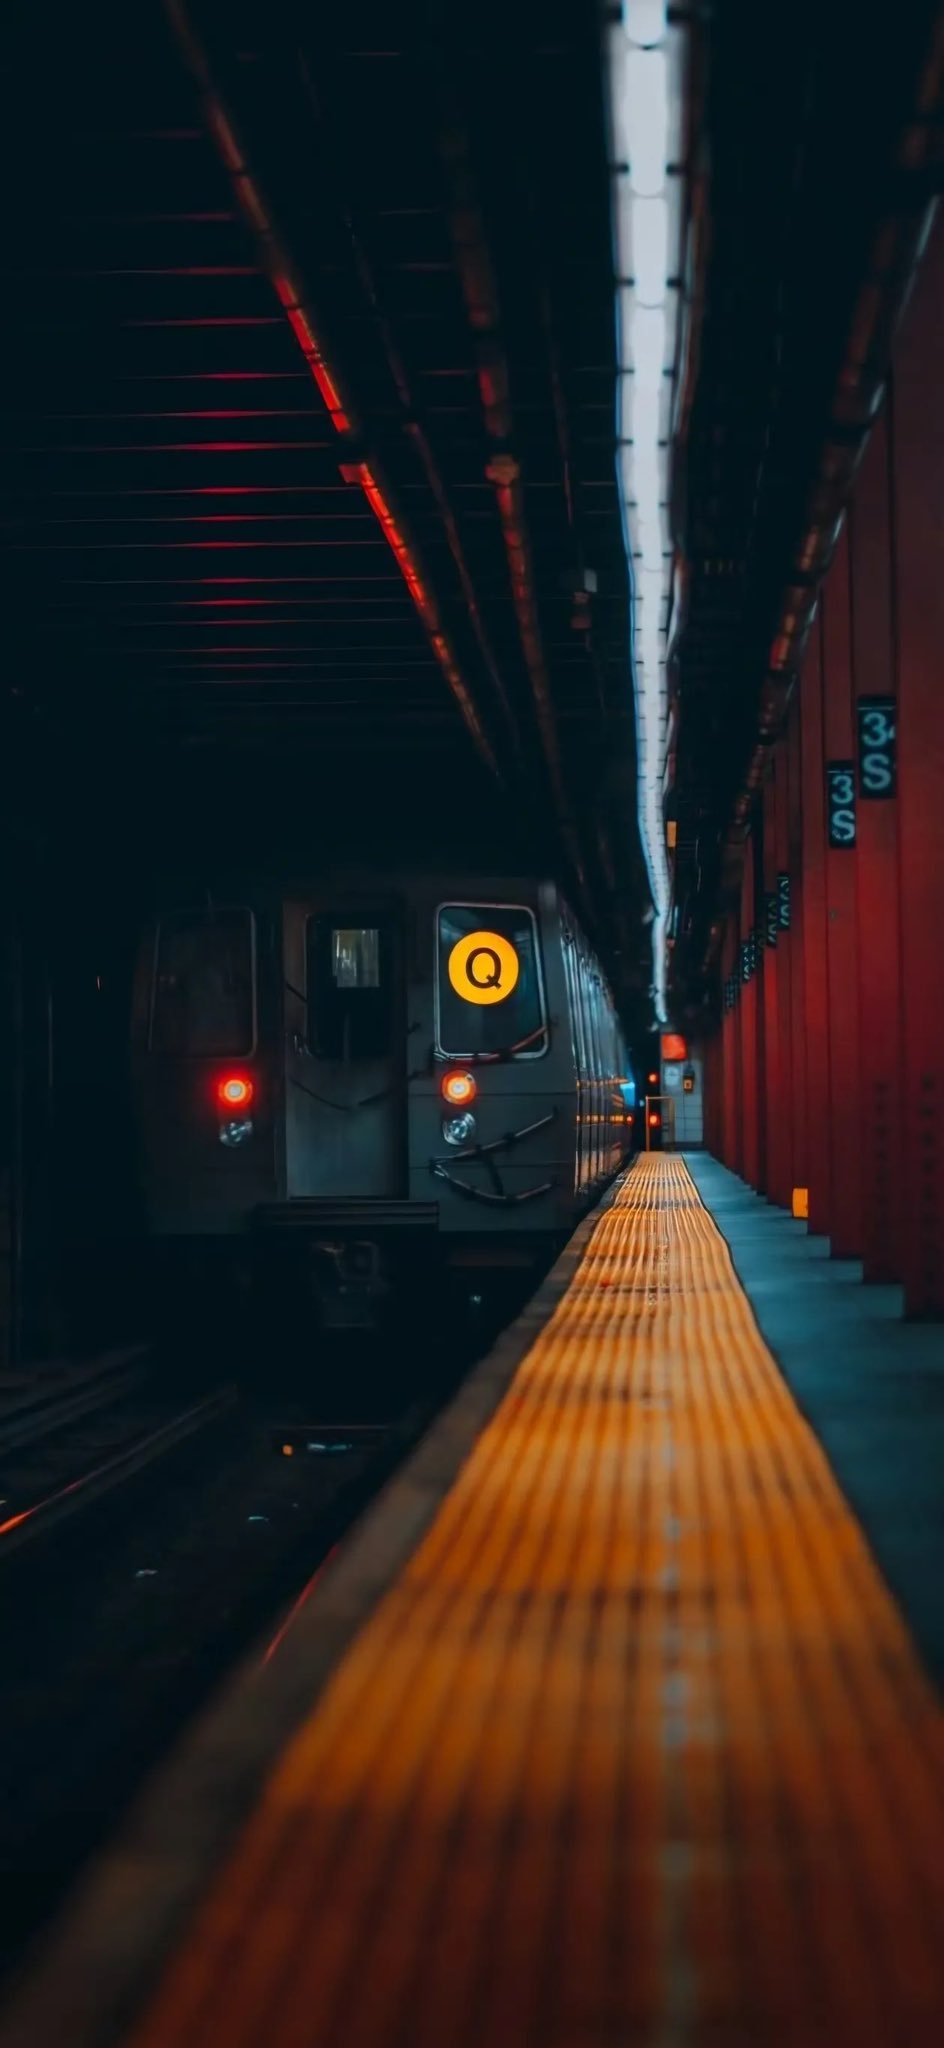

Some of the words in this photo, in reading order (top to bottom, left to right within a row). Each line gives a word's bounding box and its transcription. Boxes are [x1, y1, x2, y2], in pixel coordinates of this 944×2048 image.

[832, 775, 854, 804] 3
[832, 810, 856, 840] S
[466, 947, 501, 989] Q
